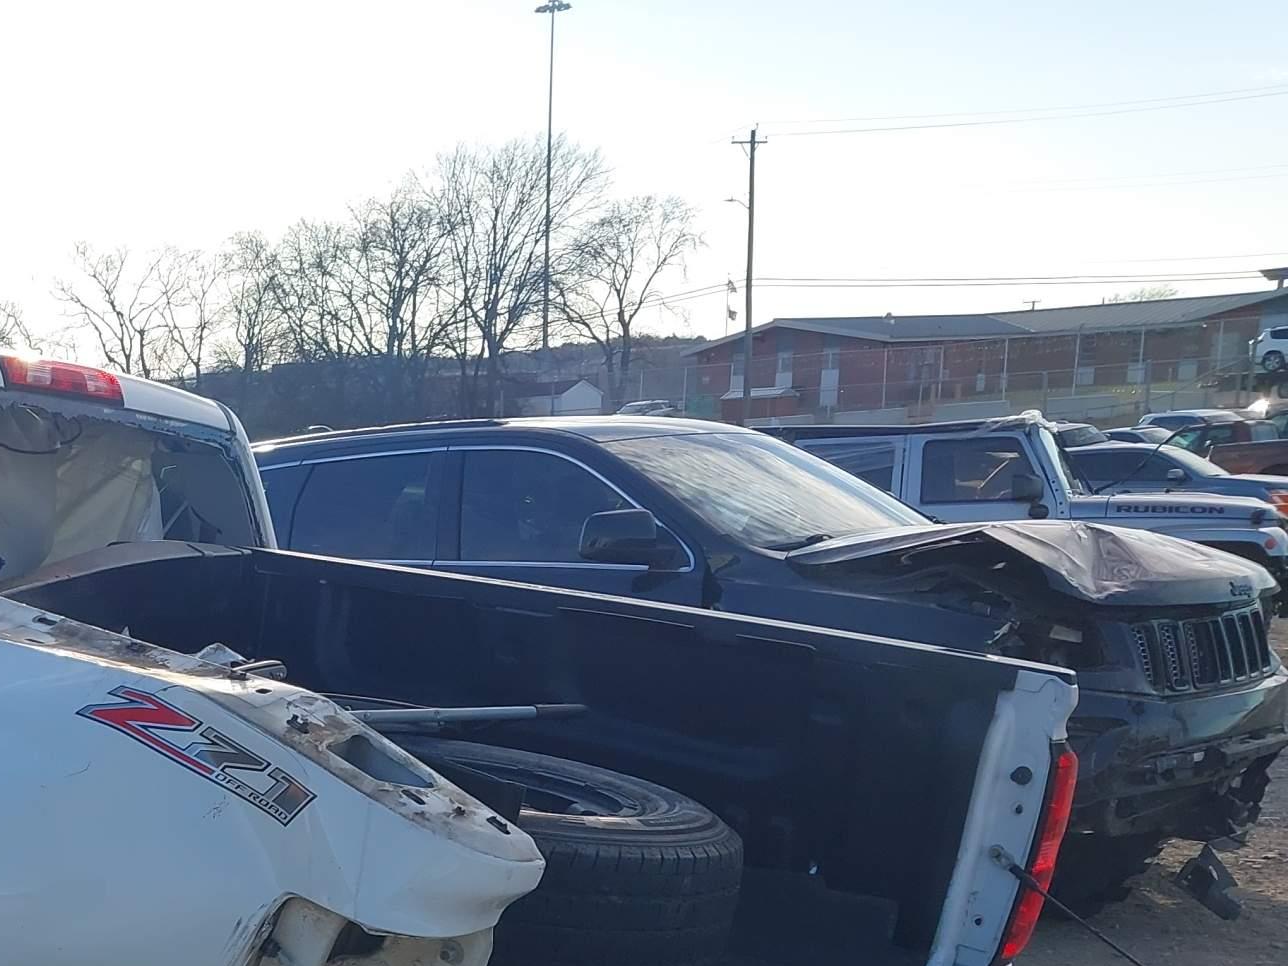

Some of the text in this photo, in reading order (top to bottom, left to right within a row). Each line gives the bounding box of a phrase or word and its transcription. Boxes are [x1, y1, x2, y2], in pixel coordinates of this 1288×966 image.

[1115, 504, 1225, 515] RUBICON
[75, 685, 318, 815] Z71
[213, 772, 289, 822] OFF ROAD
